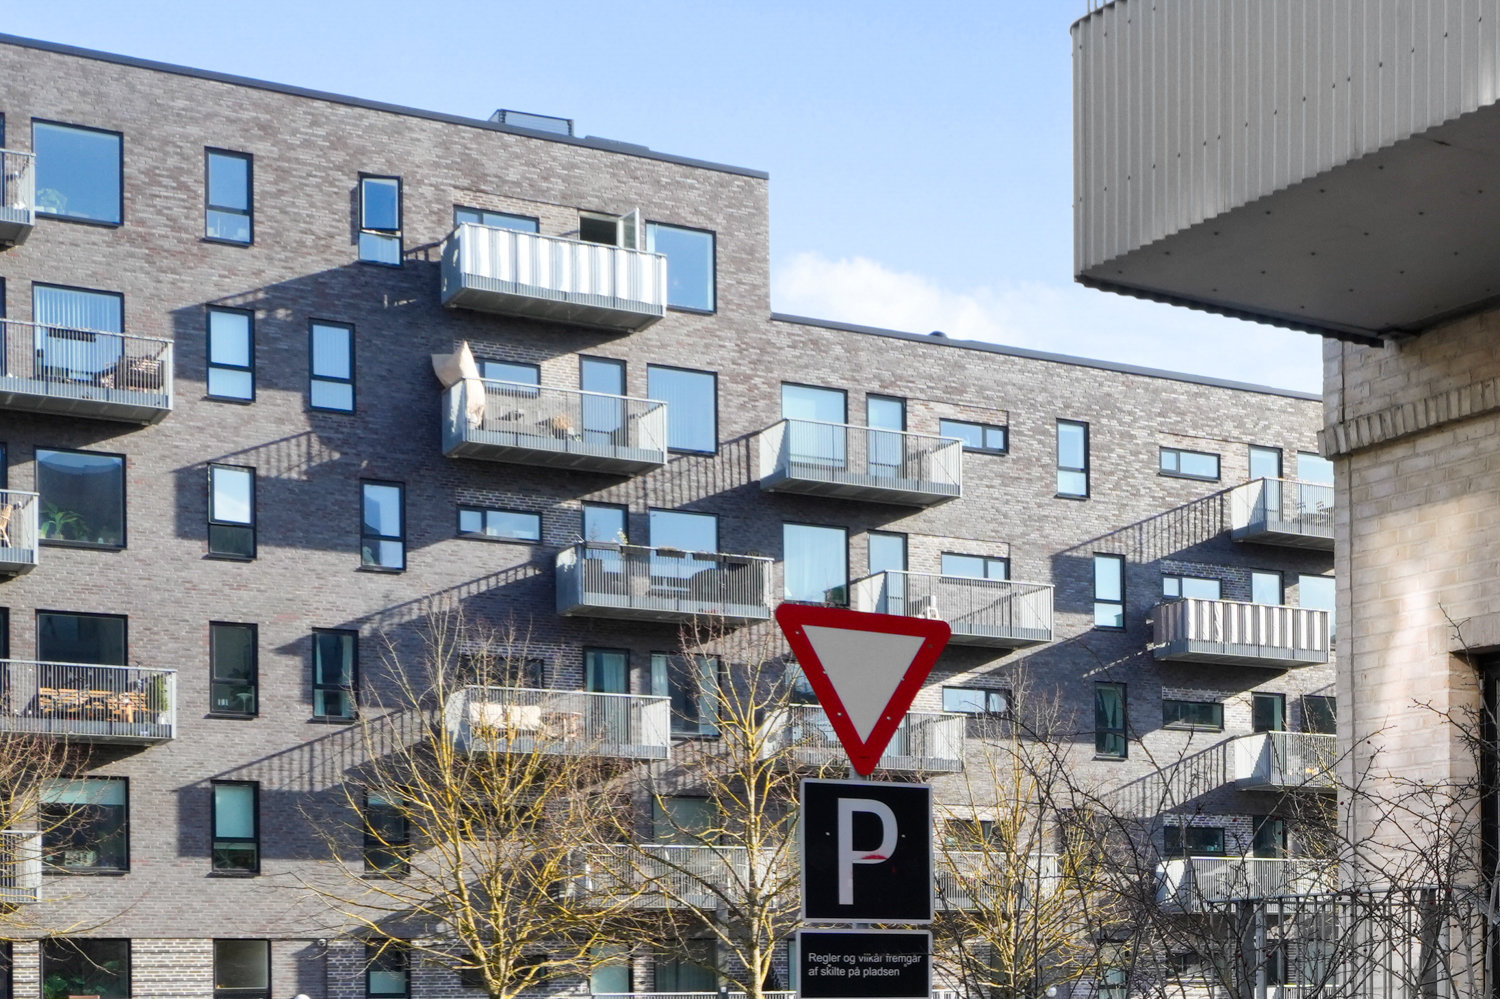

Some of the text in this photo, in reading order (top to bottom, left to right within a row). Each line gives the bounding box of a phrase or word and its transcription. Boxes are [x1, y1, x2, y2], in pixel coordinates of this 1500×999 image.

[838, 798, 898, 905] P
[808, 952, 841, 964] Regler
[843, 954, 856, 964] og
[808, 966, 900, 978] af skilte på pladsen
